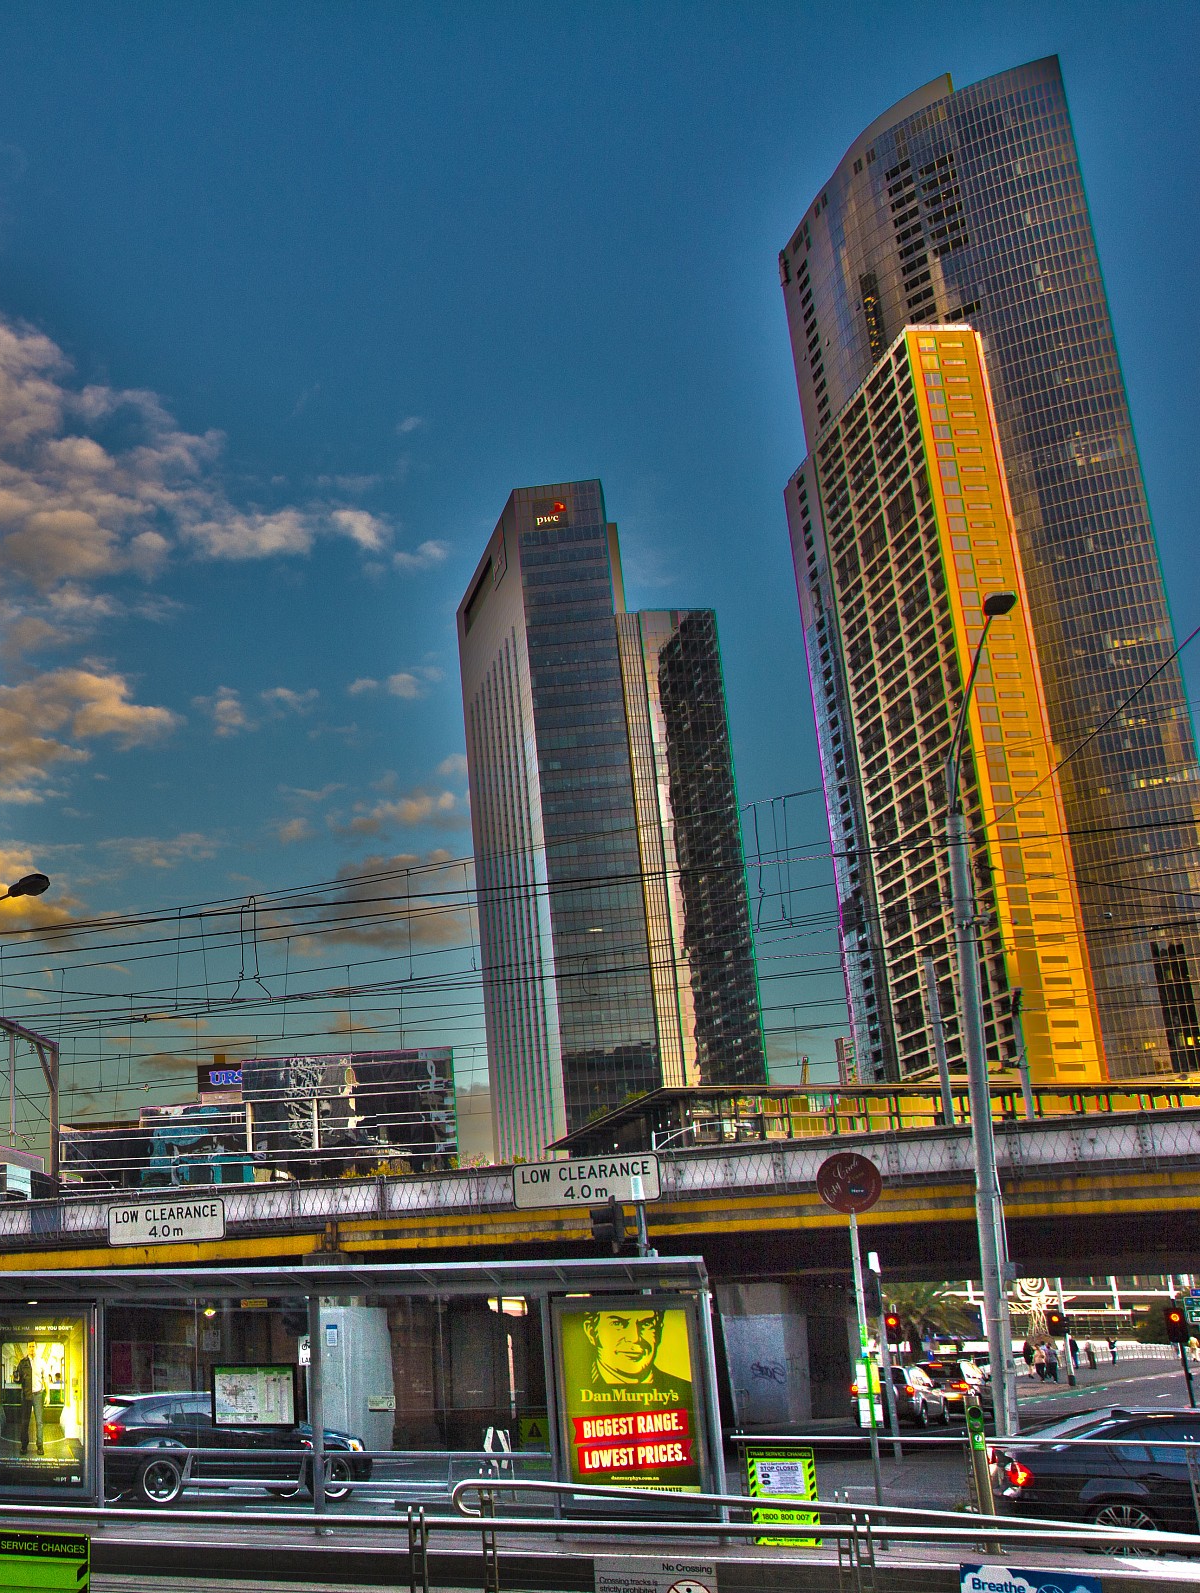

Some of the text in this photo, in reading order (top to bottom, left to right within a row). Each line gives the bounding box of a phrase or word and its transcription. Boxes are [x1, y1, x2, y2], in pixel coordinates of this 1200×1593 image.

[536, 515, 559, 526] pwc
[522, 1161, 650, 1184] LOW CLEARANCE
[115, 1205, 218, 1224] LOW CLEARANCE
[580, 1388, 679, 1405] Dan Murphy's
[583, 1412, 683, 1439] BIGGEST RANGE.
[584, 1443, 687, 1469] LOWEST PRICES.
[1, 1541, 39, 1551] SERVICE
[41, 1543, 85, 1554] CHANGES
[662, 1563, 713, 1575] No Crossing
[599, 1576, 629, 1586] Crossing
[630, 1578, 651, 1586] tracks
[600, 1585, 622, 1593] strictly
[971, 1577, 1026, 1593] Breathe
